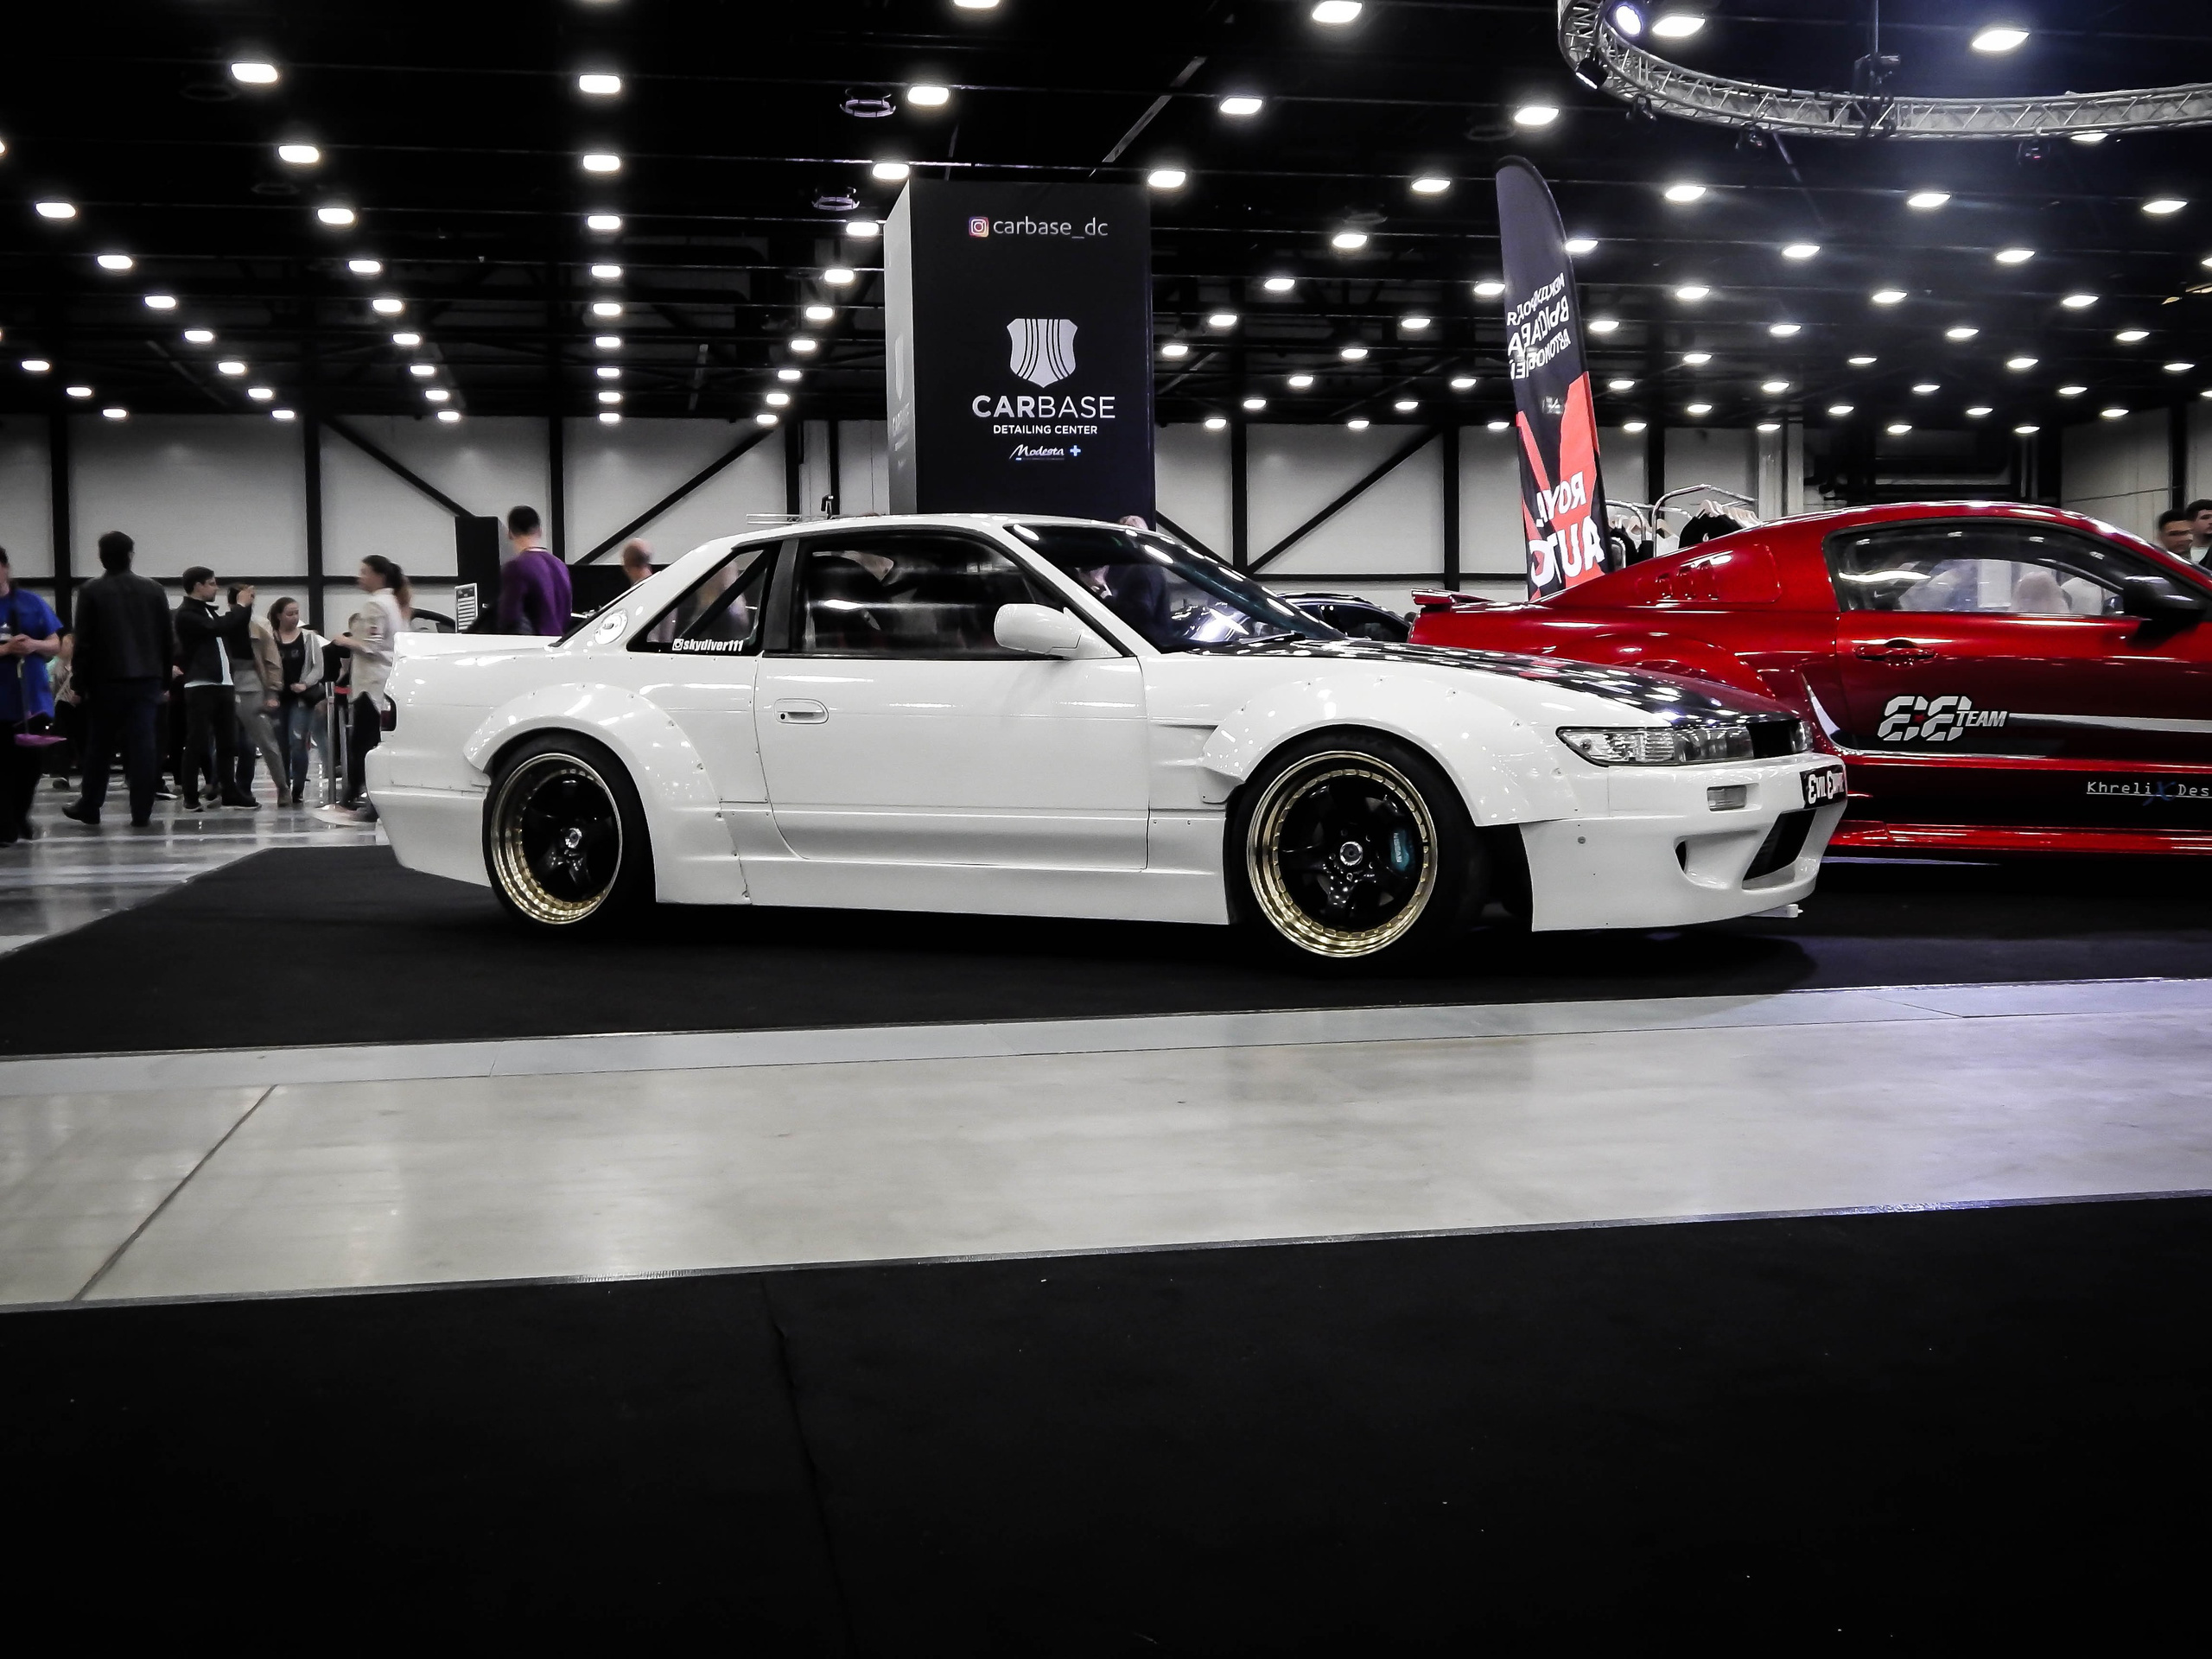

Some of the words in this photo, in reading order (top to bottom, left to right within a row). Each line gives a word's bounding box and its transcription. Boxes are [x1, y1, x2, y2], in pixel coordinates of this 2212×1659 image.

[993, 216, 1109, 238] carbase_dc
[972, 395, 1116, 418] CARBASE
[993, 424, 1052, 435] DETAILING
[1054, 424, 1097, 435] CENTER
[1009, 444, 1065, 459] Modesta
[683, 639, 744, 652] skydiver111
[1956, 710, 2008, 727] TEAM
